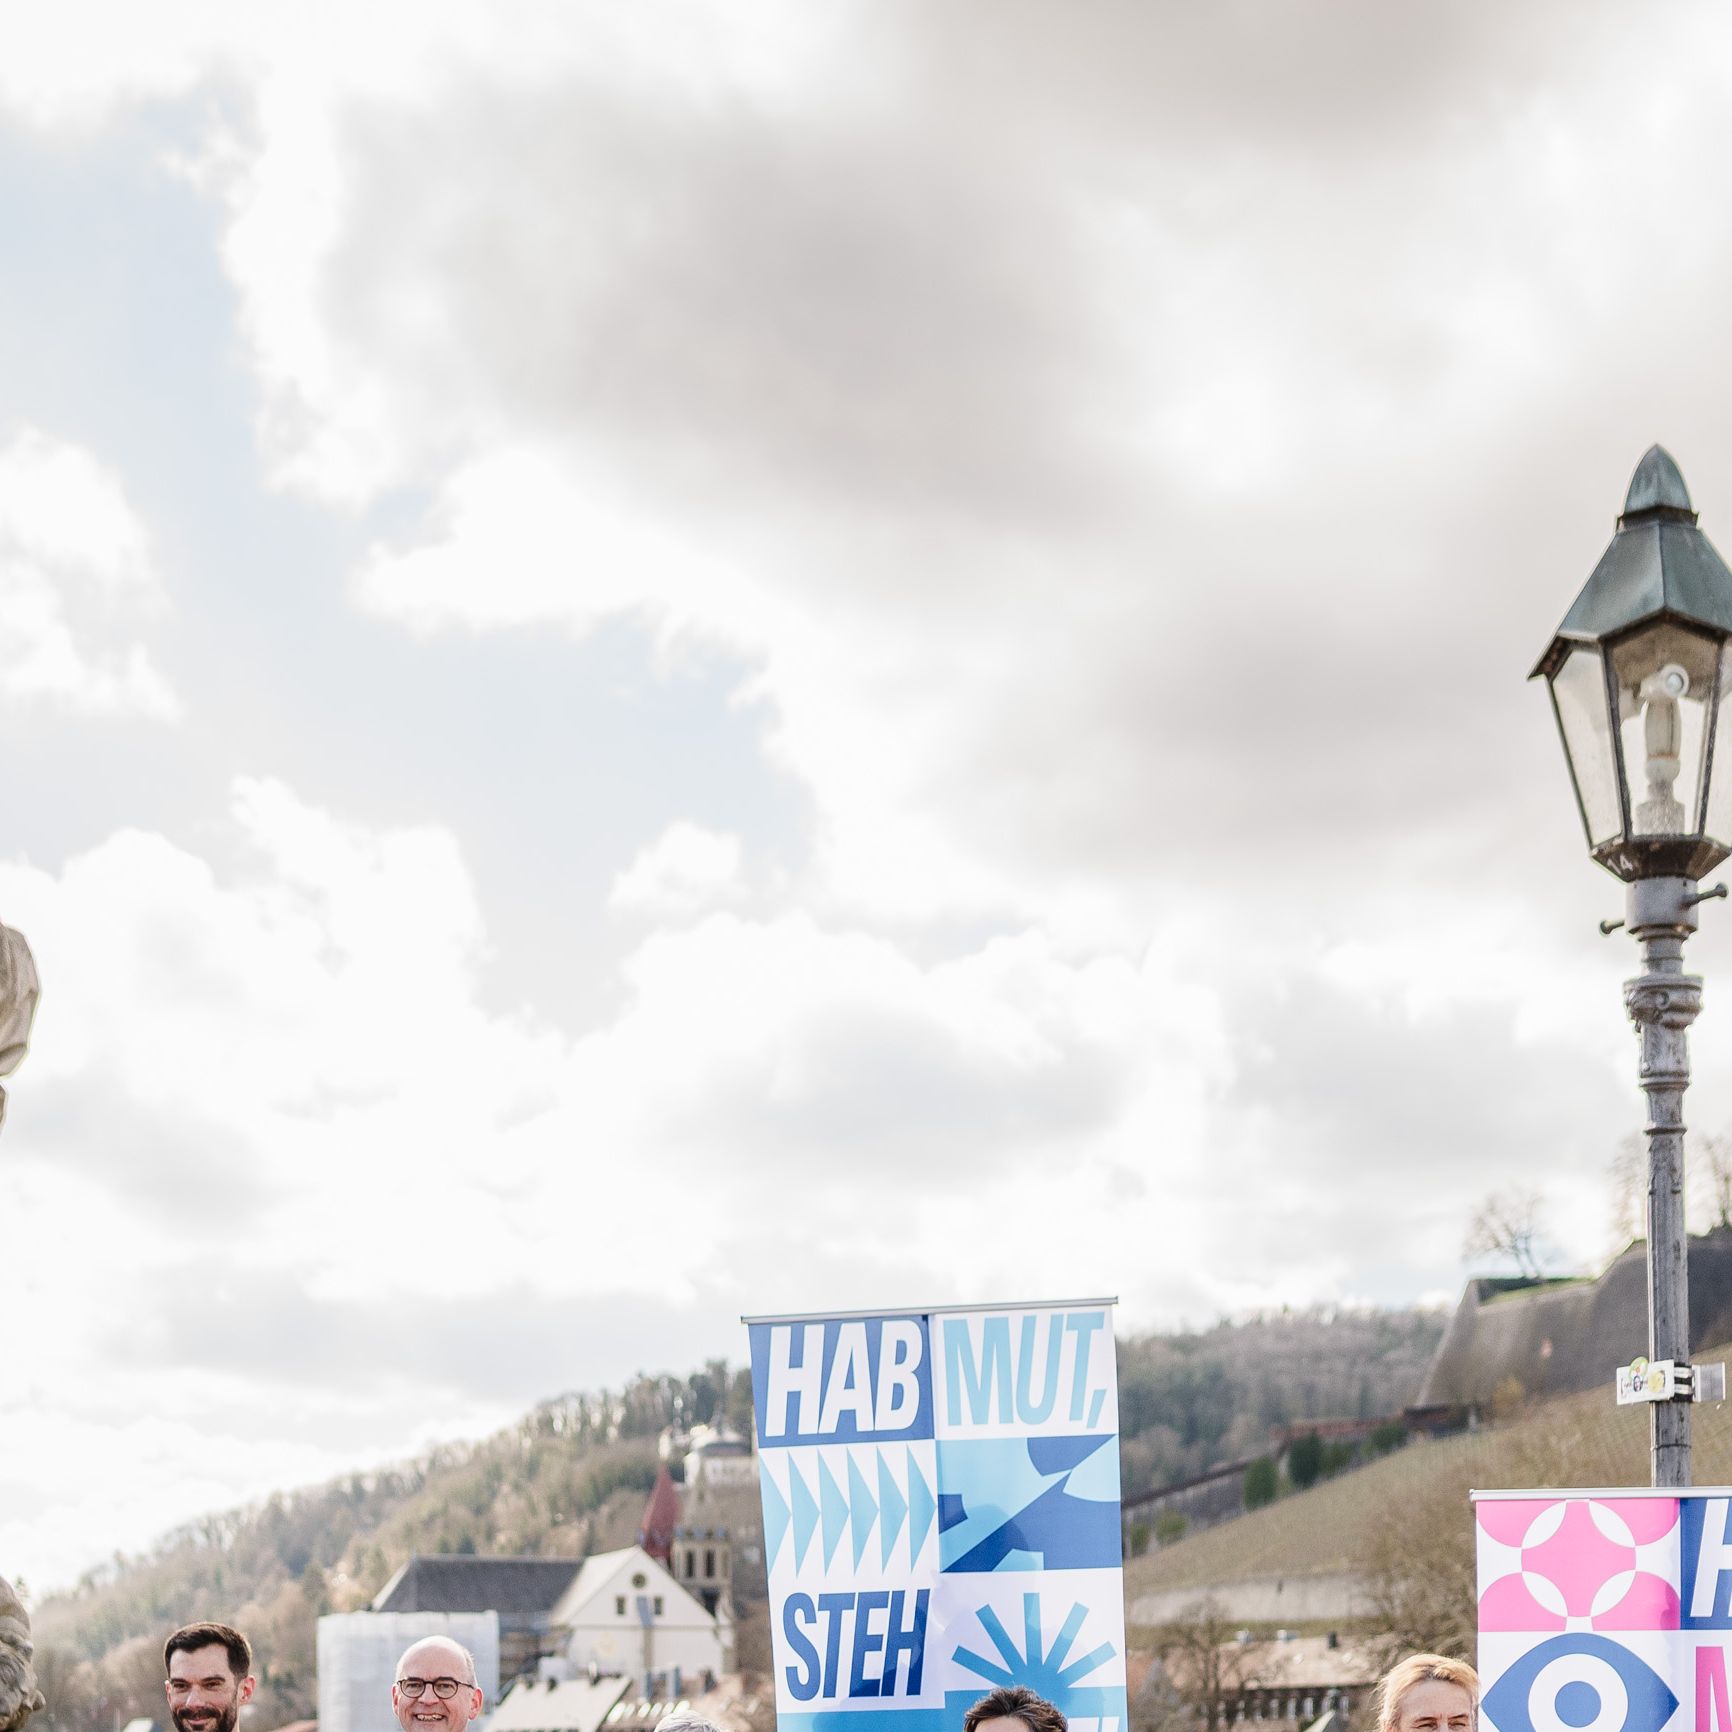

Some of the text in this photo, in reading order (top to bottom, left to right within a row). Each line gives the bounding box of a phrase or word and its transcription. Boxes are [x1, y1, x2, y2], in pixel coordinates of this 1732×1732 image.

[765, 1311, 1108, 1437] HAB MUT,
[783, 1588, 931, 1702] STEH
